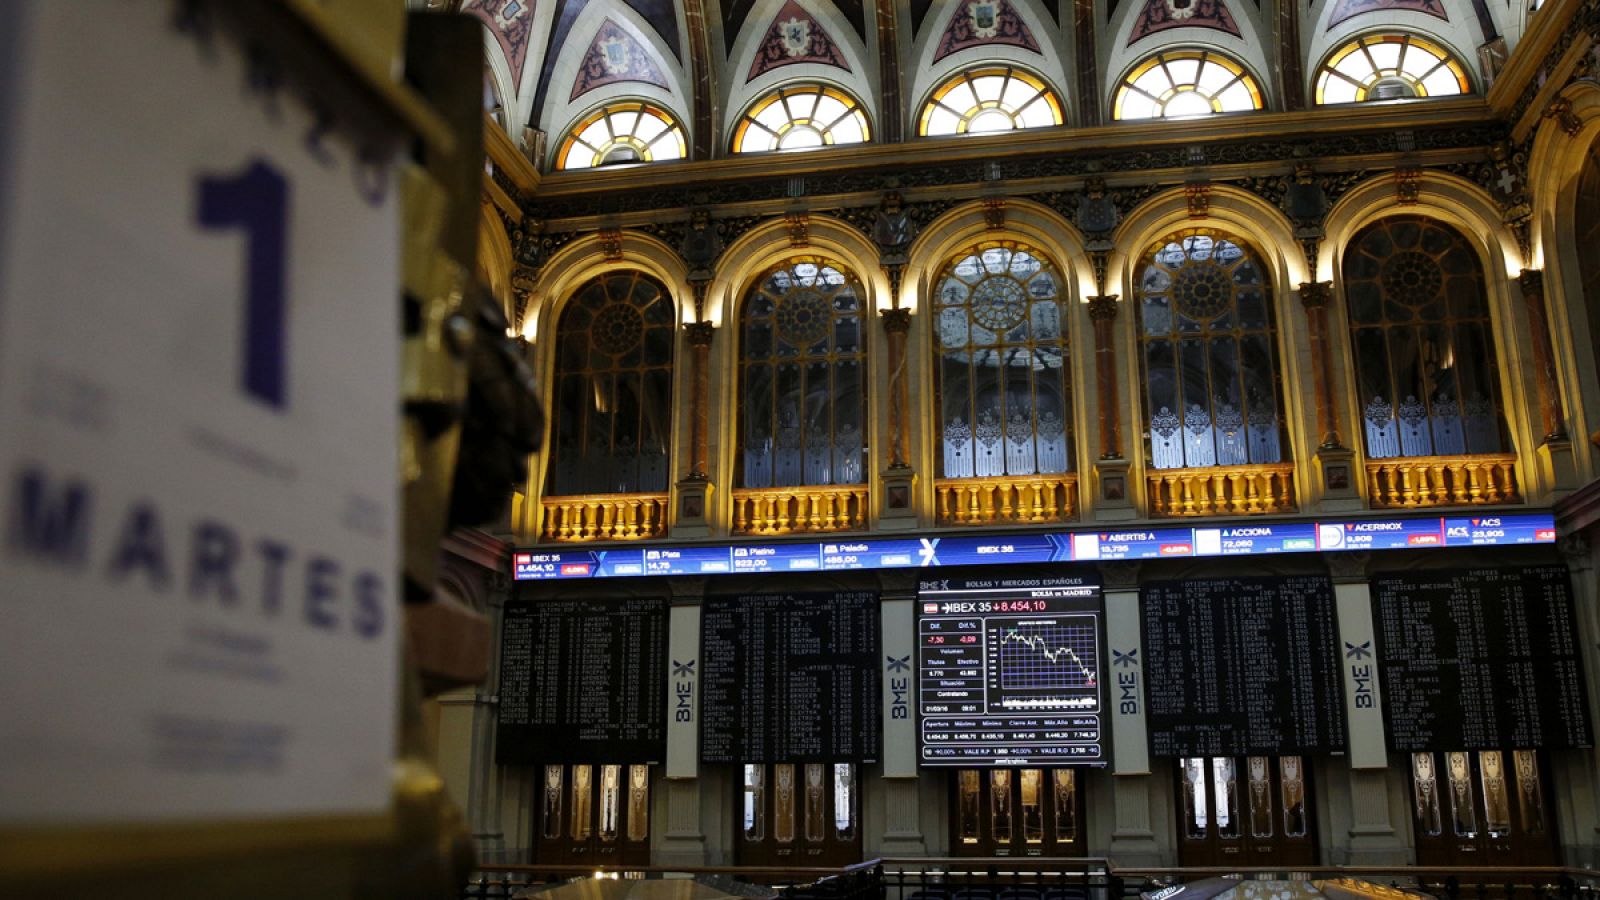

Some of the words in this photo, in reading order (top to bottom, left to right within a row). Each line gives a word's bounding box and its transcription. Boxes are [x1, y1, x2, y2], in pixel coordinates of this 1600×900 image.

[191, 154, 294, 413] 1
[1109, 533, 1147, 542] ABERTIS
[1231, 528, 1272, 536] ACCIONA
[1355, 523, 1402, 531] ACERINOX
[6, 461, 387, 640] MARTES
[1002, 579, 1040, 587] MERCADOS
[1043, 578, 1083, 586] ESPAÑOLES
[950, 603, 976, 612] IBEX
[978, 602, 992, 612] 35
[1001, 601, 1046, 612] 8.454,10
[676, 681, 691, 722] BME
[891, 677, 907, 719] BME
[1118, 672, 1137, 715] BME
[1352, 665, 1372, 709] BME
